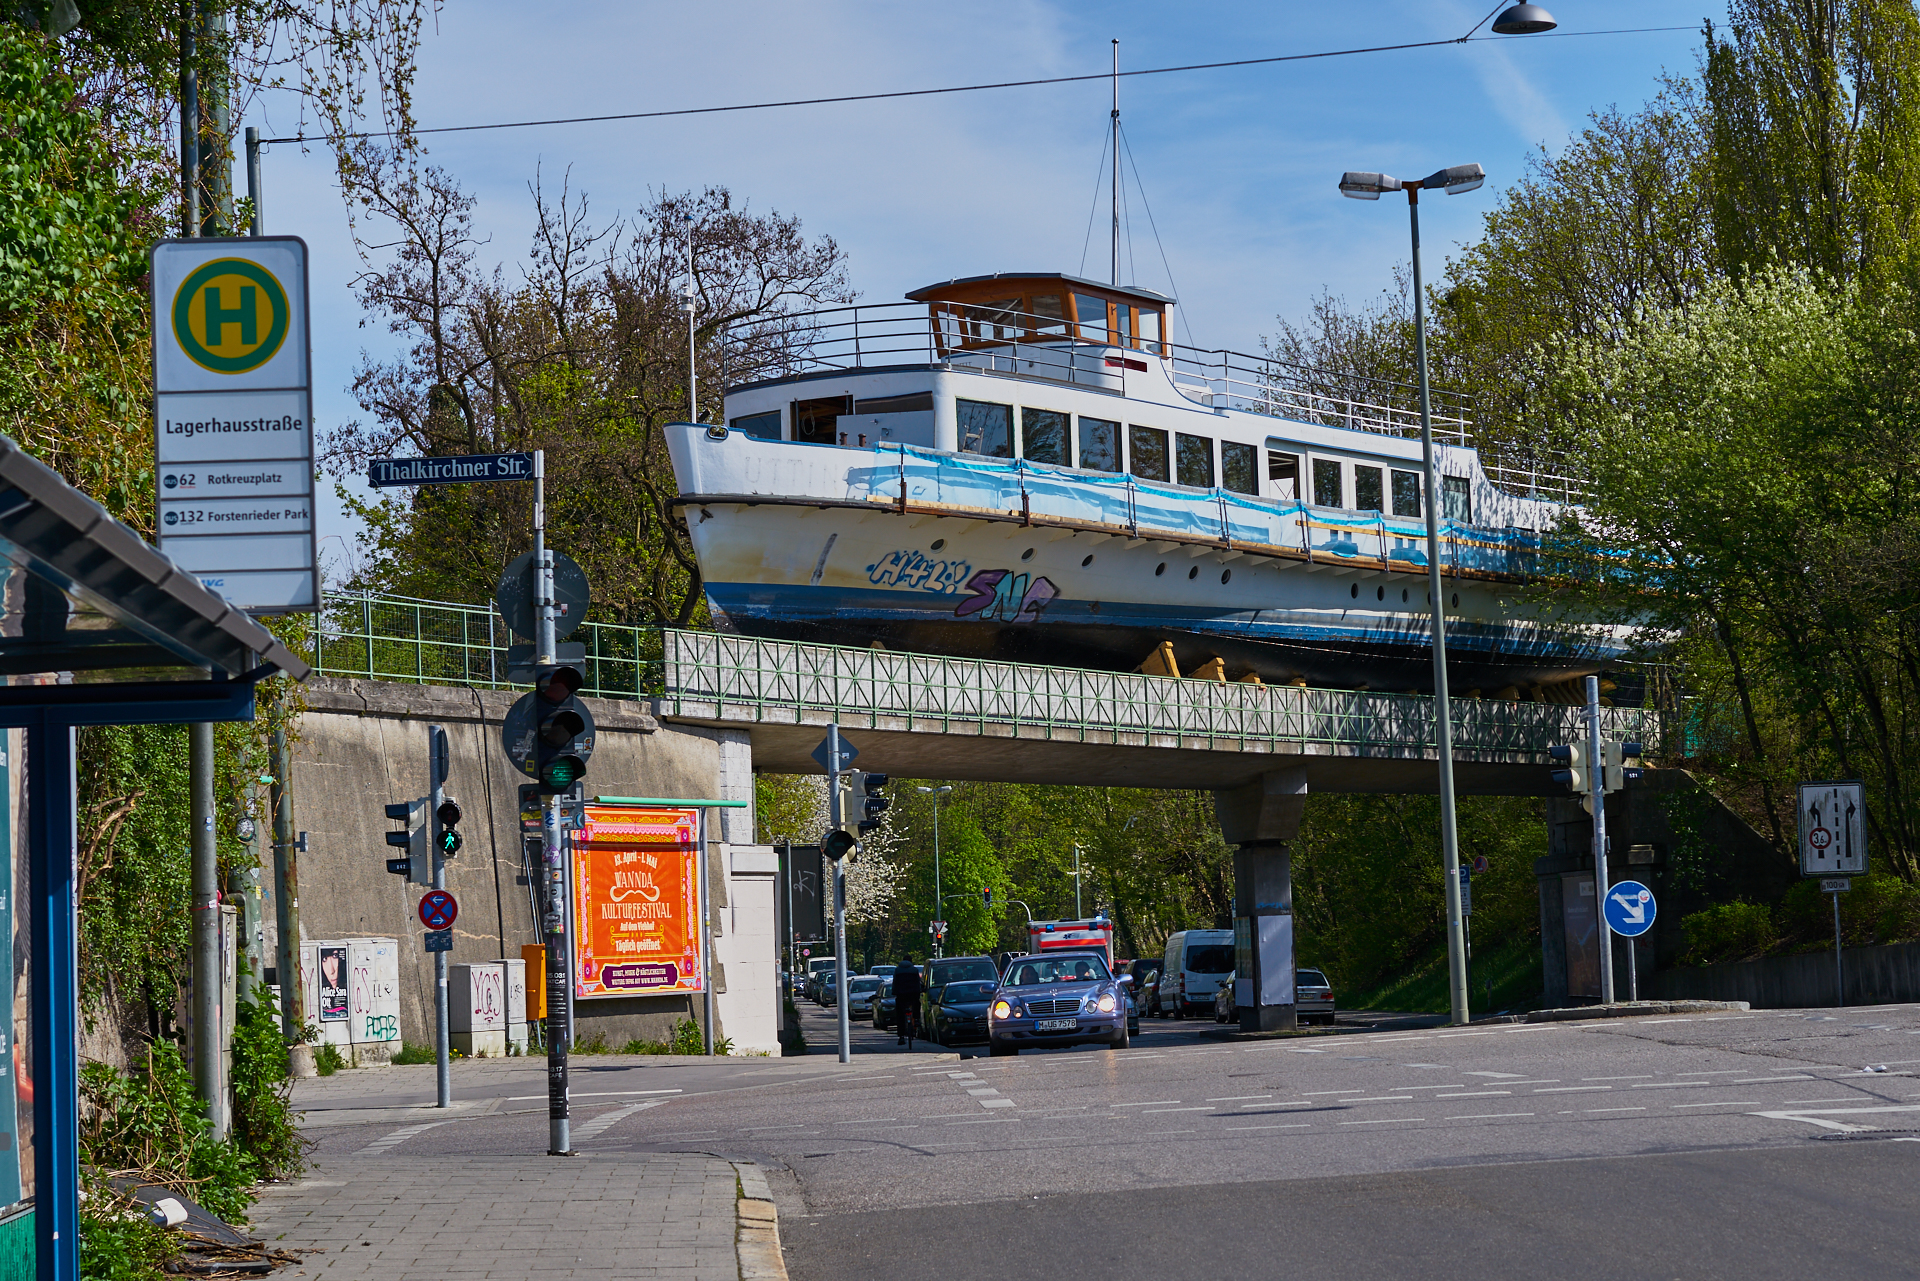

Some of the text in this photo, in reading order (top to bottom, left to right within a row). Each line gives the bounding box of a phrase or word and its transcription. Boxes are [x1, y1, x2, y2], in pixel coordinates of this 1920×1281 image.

[205, 286, 257, 346] H
[166, 415, 302, 437] Lagerhausstraße
[377, 456, 526, 481] Thalkirchner Str.
[180, 473, 196, 486] 62
[208, 473, 282, 486] Rotkreuzplatz
[179, 510, 204, 522] 132
[208, 510, 280, 522] Forstenrieder
[284, 508, 309, 520] Park
[623, 852, 637, 865] April
[614, 871, 653, 888] WANNDA
[601, 902, 672, 920] KULTURFESTIVAL
[323, 986, 347, 997] Alice Sara
[322, 997, 332, 1008] Ott
